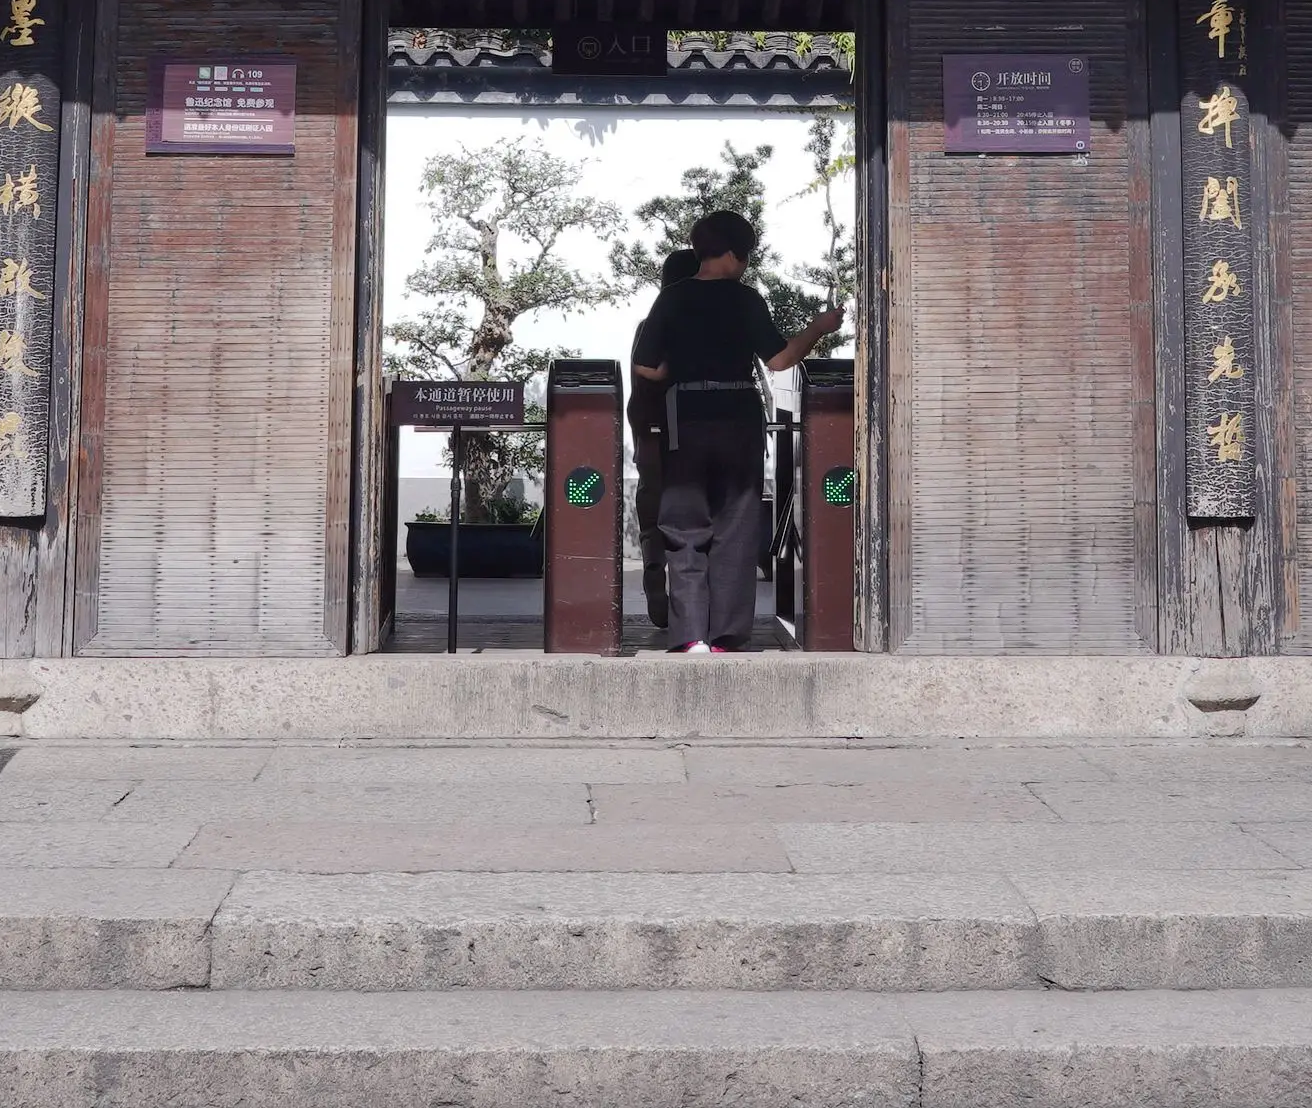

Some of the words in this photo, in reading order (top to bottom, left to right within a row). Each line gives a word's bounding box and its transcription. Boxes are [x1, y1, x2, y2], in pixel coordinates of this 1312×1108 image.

[606, 35, 652, 55] 入口
[247, 70, 263, 79] 109
[995, 71, 1051, 86] 开放时间
[185, 97, 233, 108] 鲁迅纪念馆
[237, 98, 275, 109] 免费参观
[415, 387, 515, 403] 本通道暂停使用
[435, 405, 473, 413] Passageway
